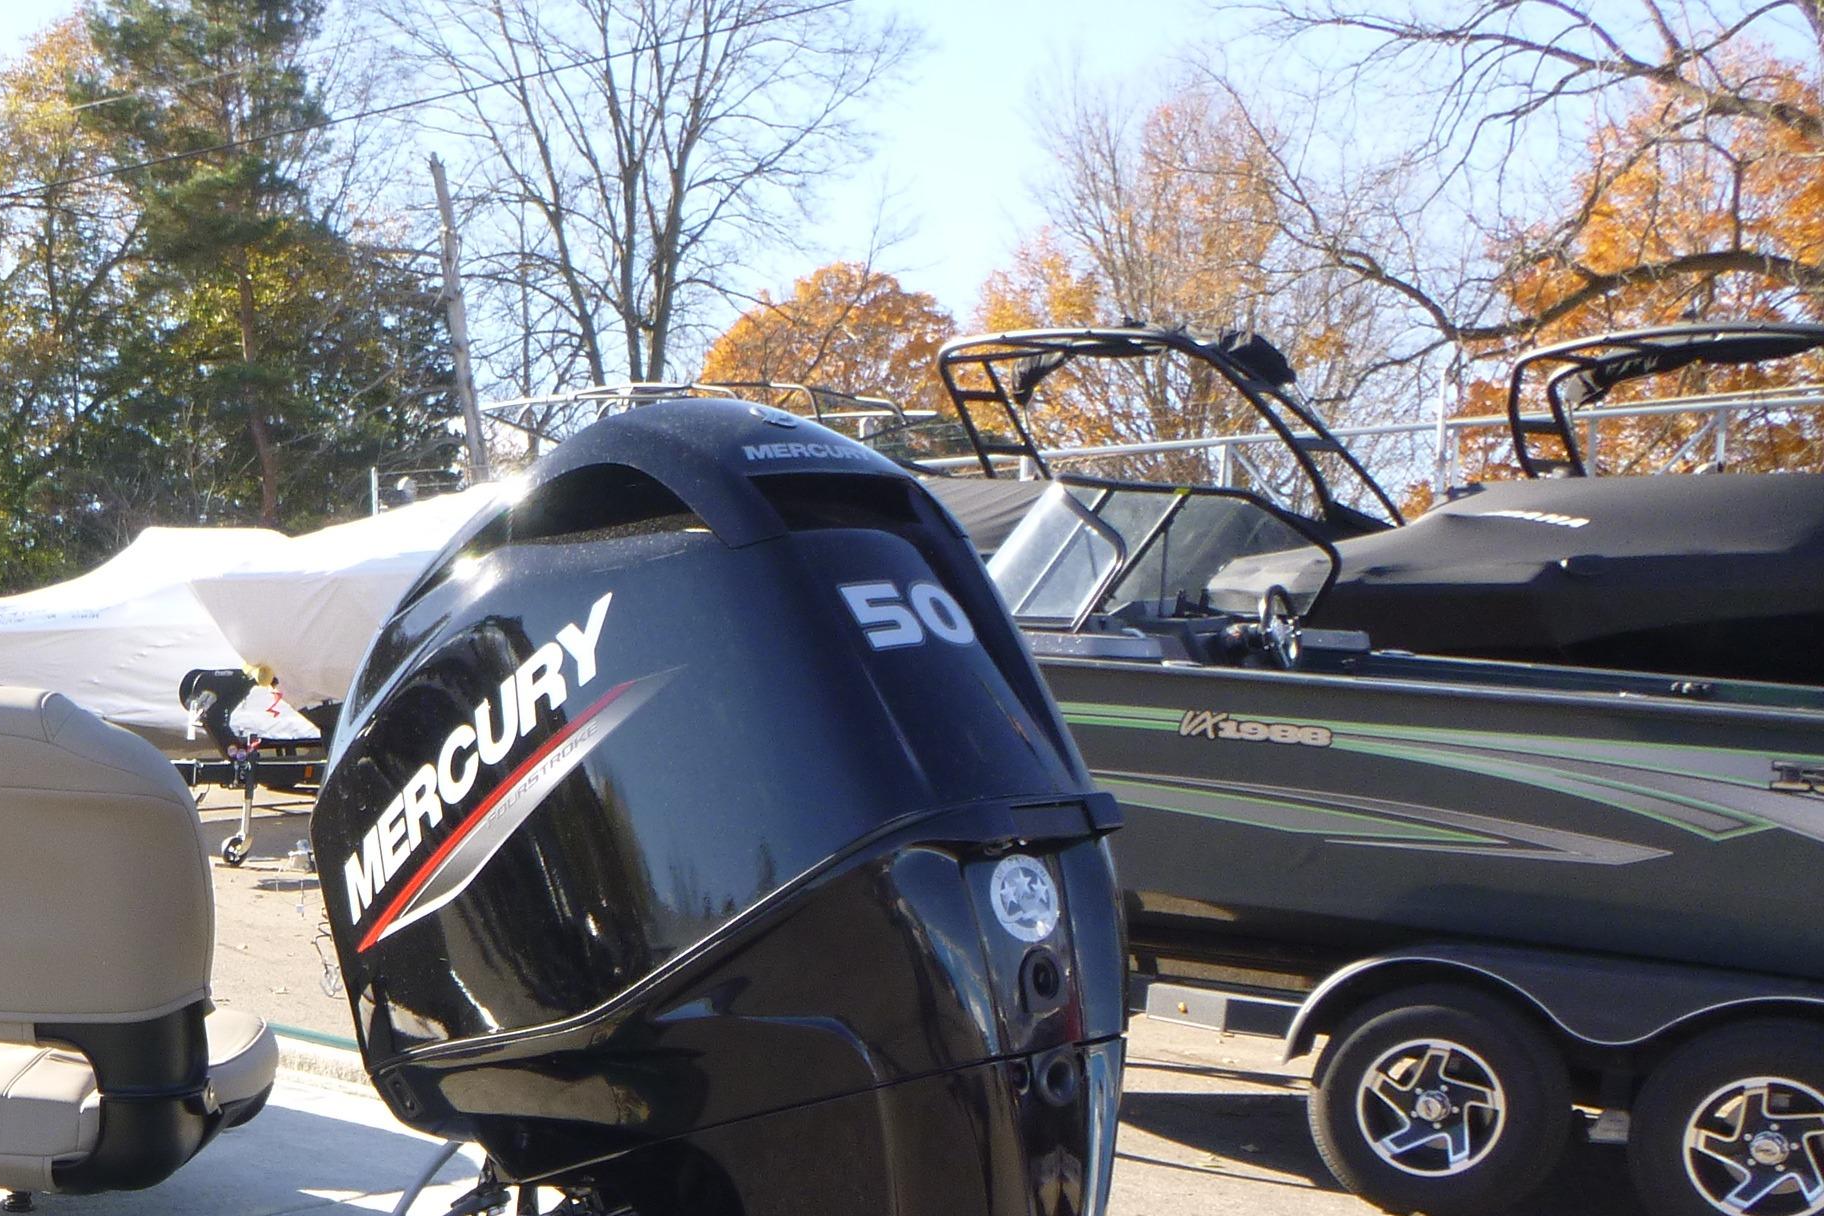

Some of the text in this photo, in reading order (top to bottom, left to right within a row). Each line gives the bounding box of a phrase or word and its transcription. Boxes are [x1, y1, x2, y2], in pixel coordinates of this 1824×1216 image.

[742, 441, 871, 462] MERCURY
[837, 581, 975, 650] 50
[344, 591, 614, 926] MERCURY
[486, 719, 599, 830] FOURSTROKE
